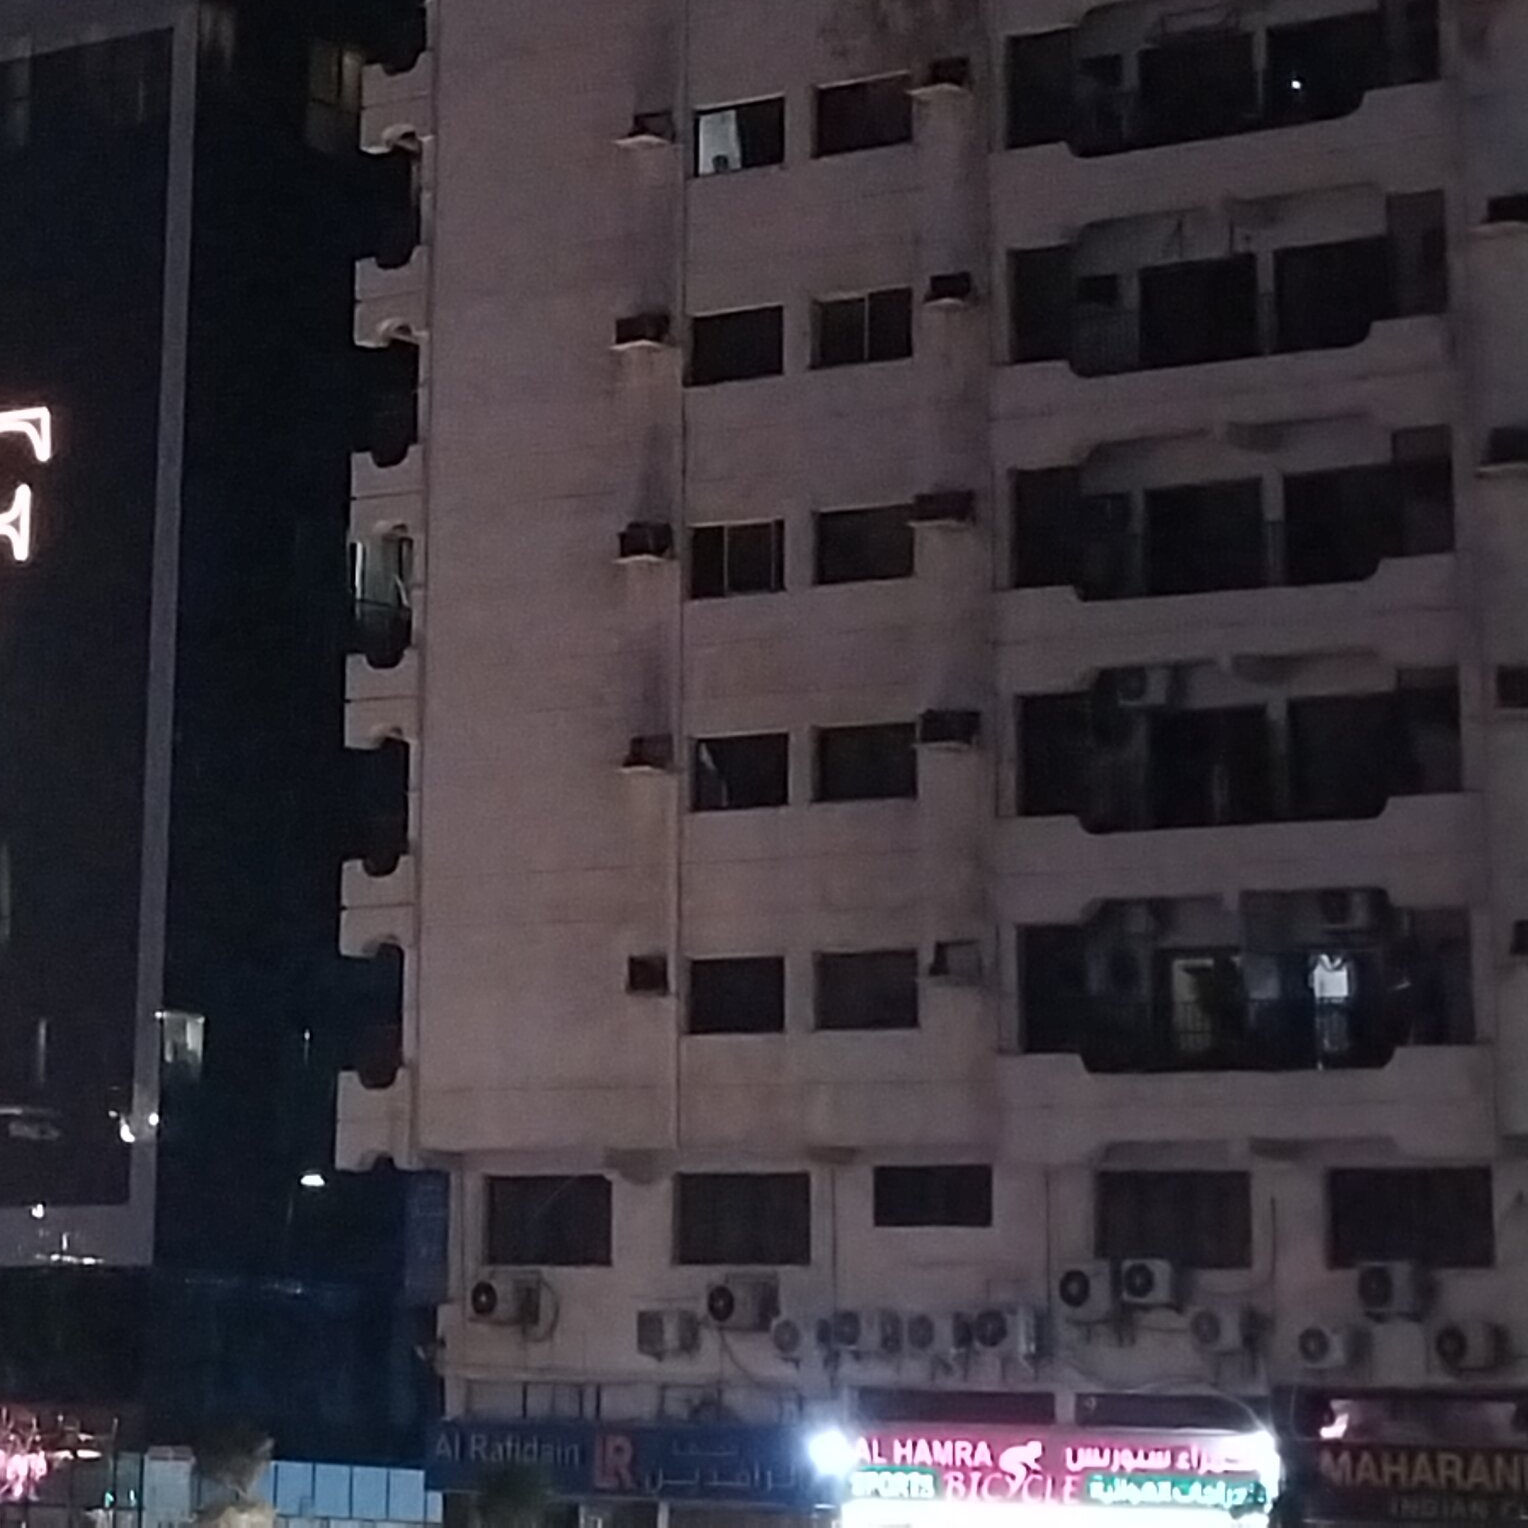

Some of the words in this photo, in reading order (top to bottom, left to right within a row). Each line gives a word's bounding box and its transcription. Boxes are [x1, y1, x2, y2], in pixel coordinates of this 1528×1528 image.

[470, 1433, 579, 1466] Rafidain
[856, 1437, 886, 1464] AL
[892, 1437, 993, 1467] HAMRA
[944, 1471, 1081, 1505] BICYCLE
